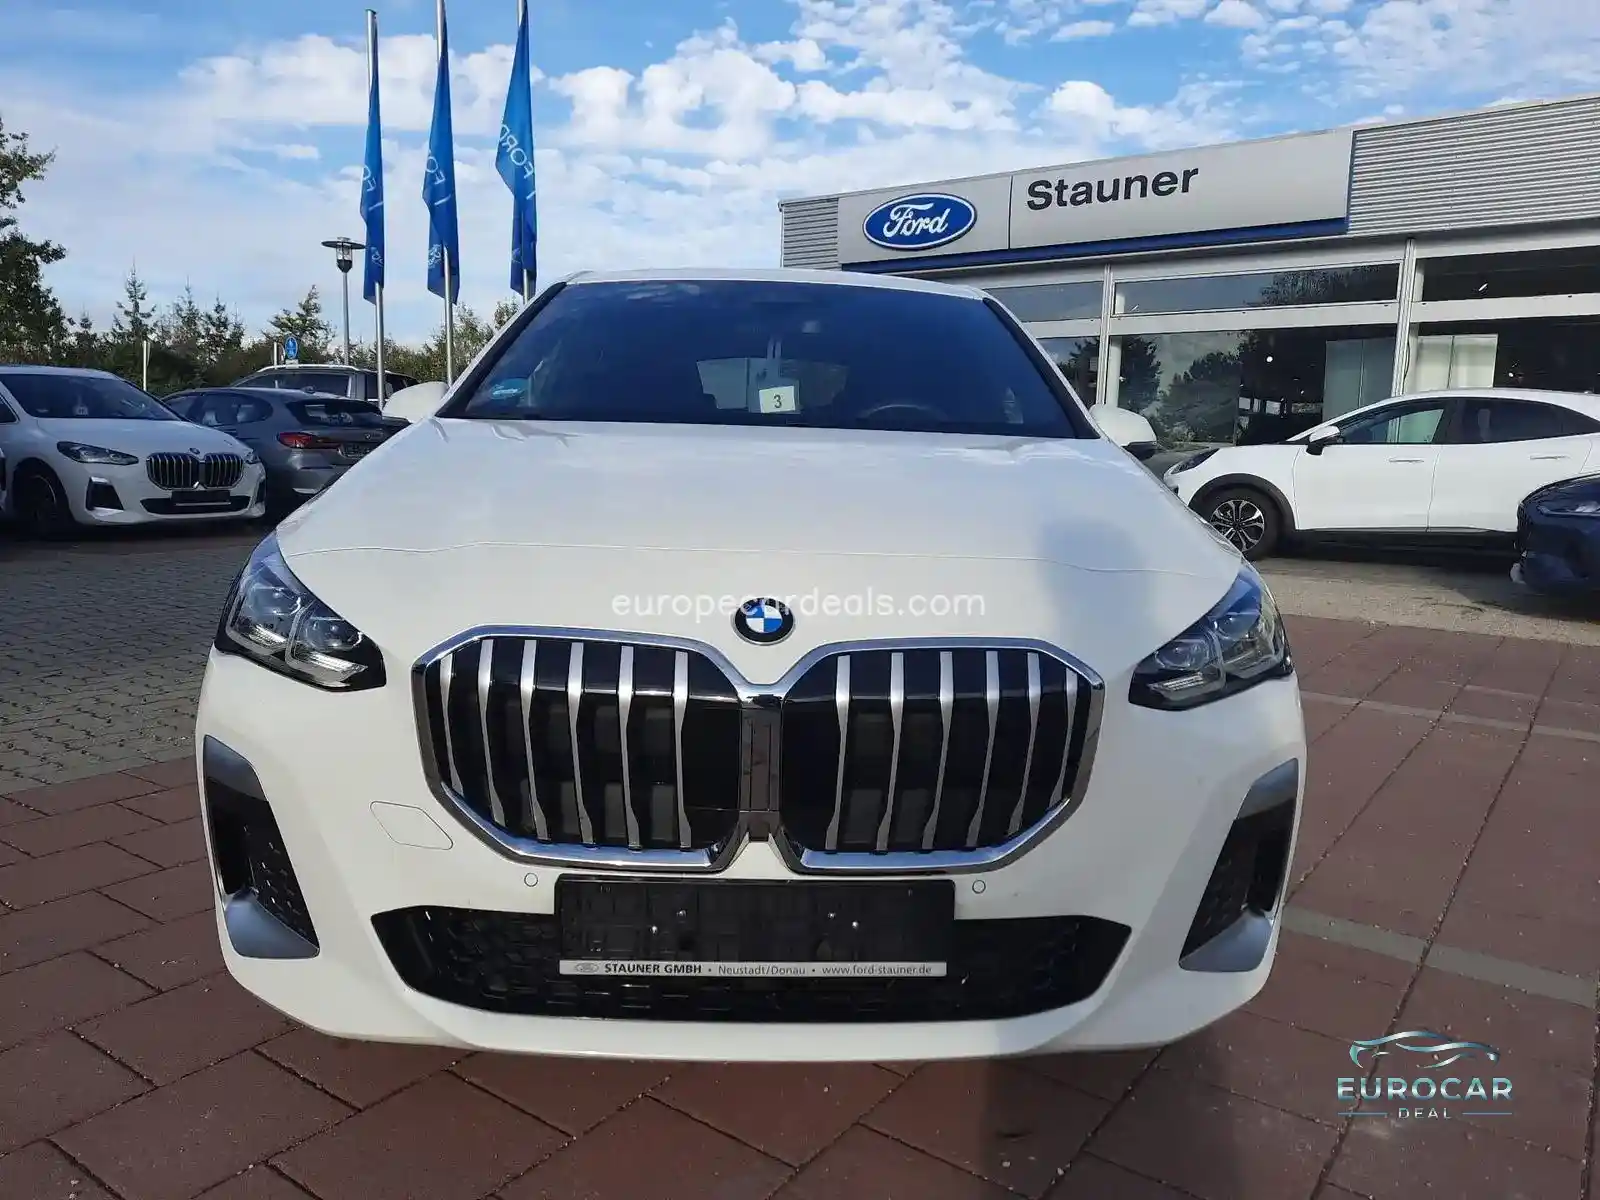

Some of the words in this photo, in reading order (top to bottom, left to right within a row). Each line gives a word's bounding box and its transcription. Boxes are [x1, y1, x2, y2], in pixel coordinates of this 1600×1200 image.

[1026, 167, 1199, 211] Stauner
[882, 203, 950, 237] Ford
[773, 394, 782, 409] 3
[604, 963, 660, 974] STAUNER
[664, 964, 702, 974] GMBH
[718, 965, 806, 976] Neustadt/Donau
[822, 965, 932, 976] www.ford-stauner.de
